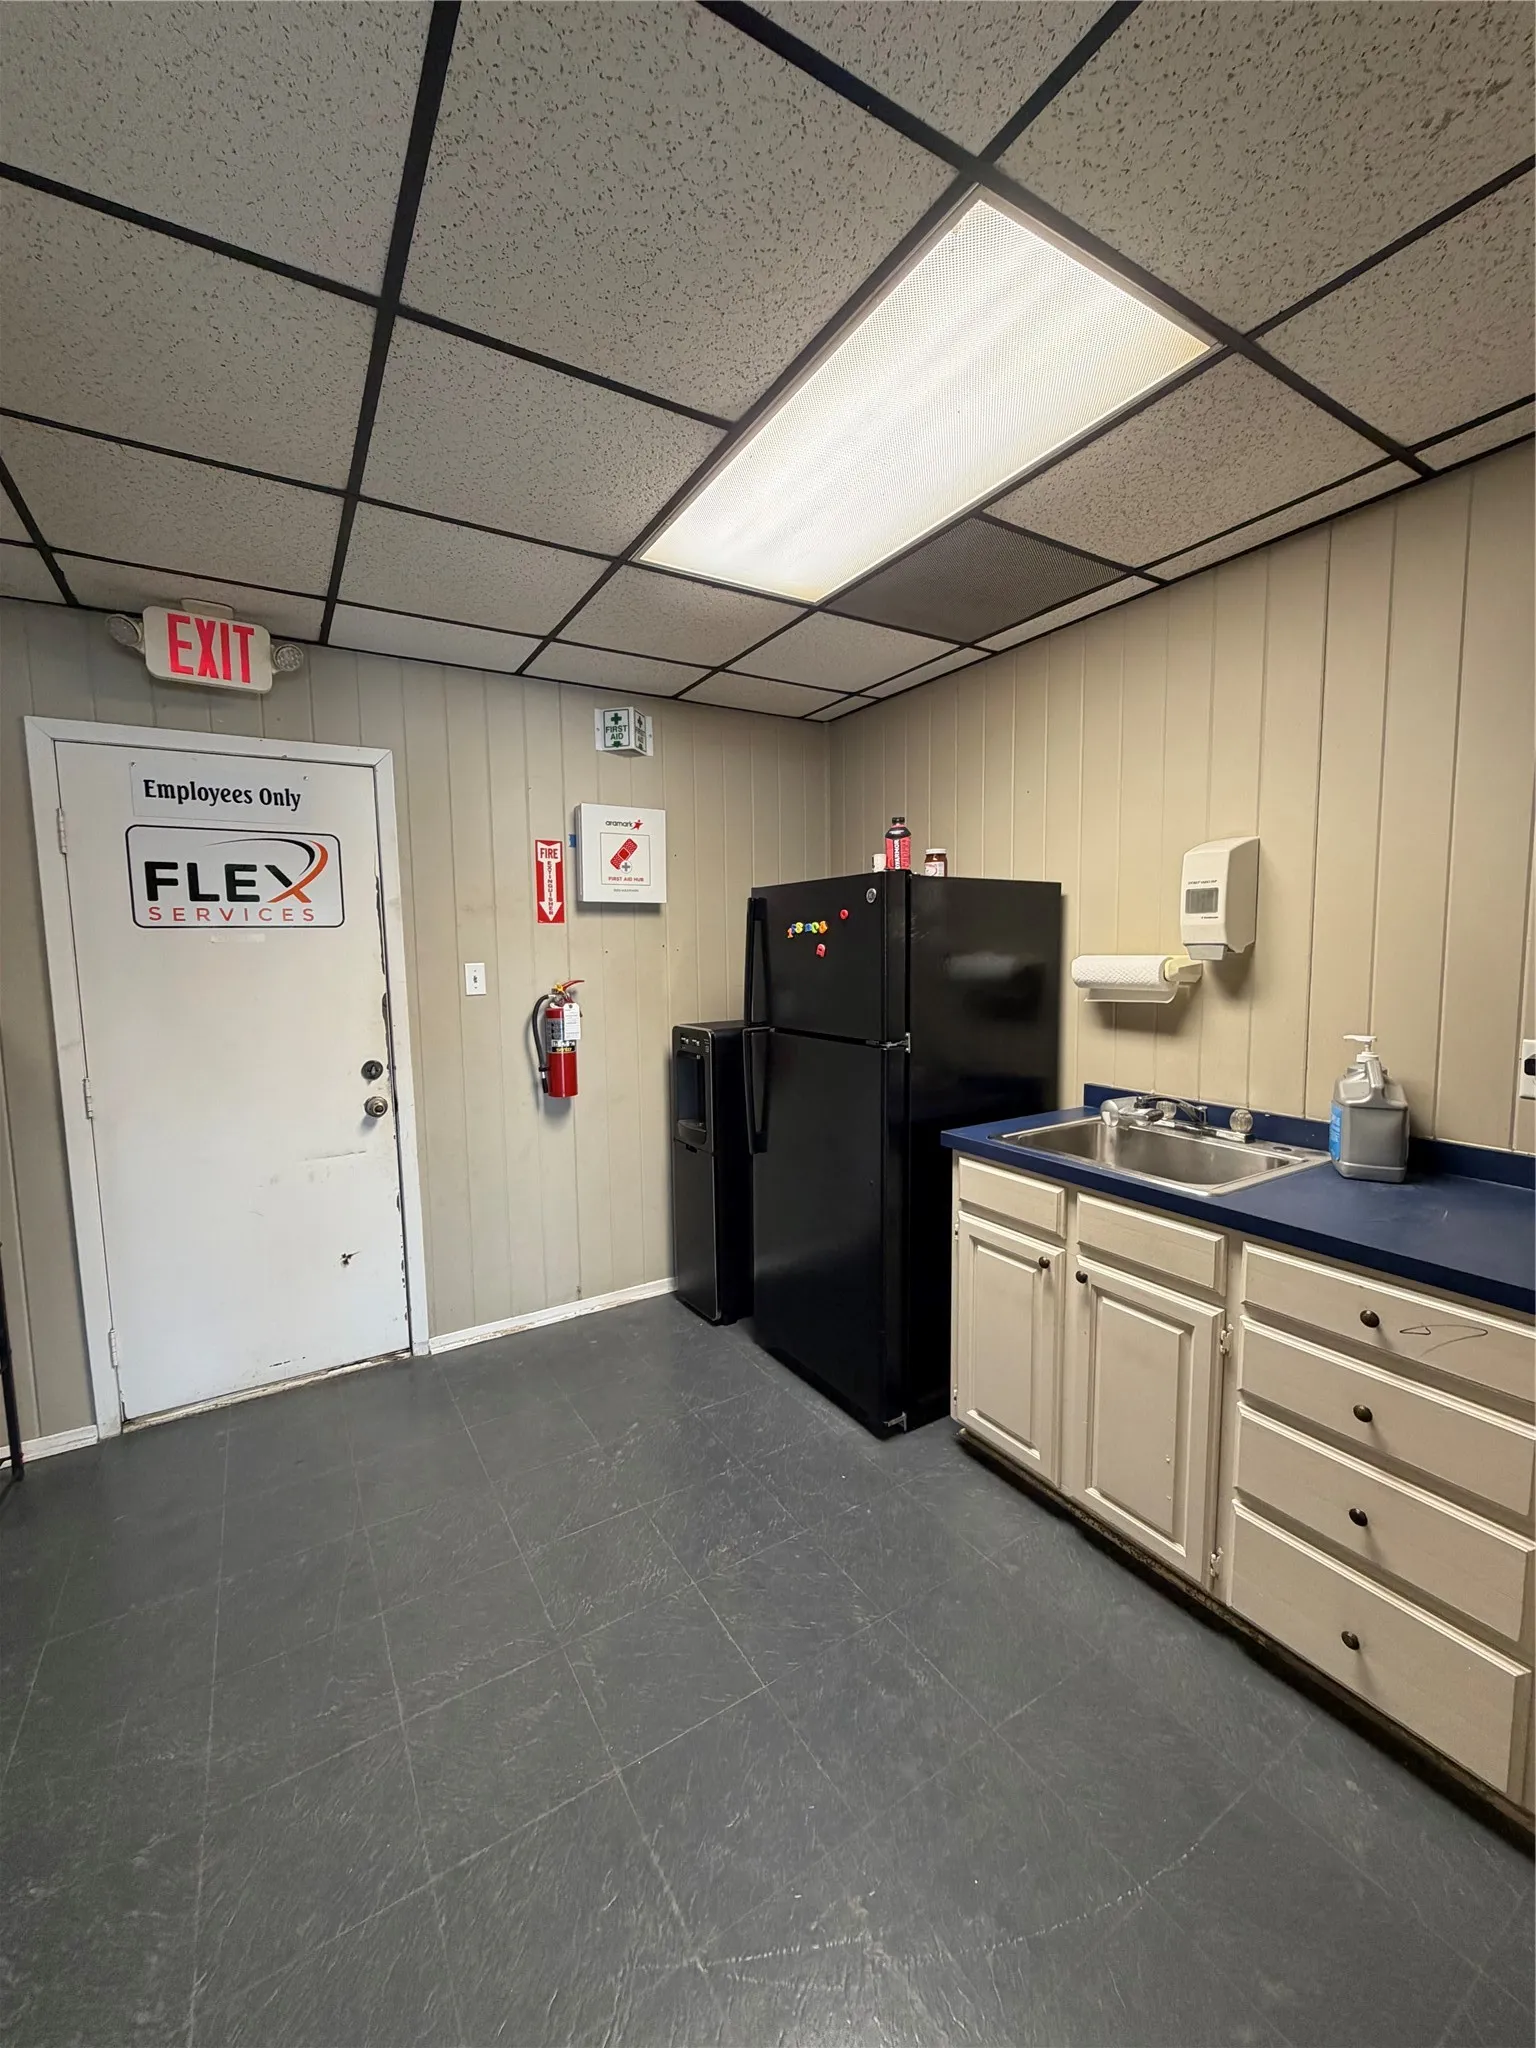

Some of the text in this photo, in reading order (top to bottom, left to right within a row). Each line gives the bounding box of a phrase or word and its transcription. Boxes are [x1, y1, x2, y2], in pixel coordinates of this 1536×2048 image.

[167, 613, 254, 684] EXIT
[605, 725, 628, 733] FIRST
[143, 779, 301, 811] Employees Only
[605, 820, 633, 828] aramark
[540, 848, 559, 859] FIRE
[144, 845, 328, 903] FLEX
[148, 906, 315, 922] SERVICES
